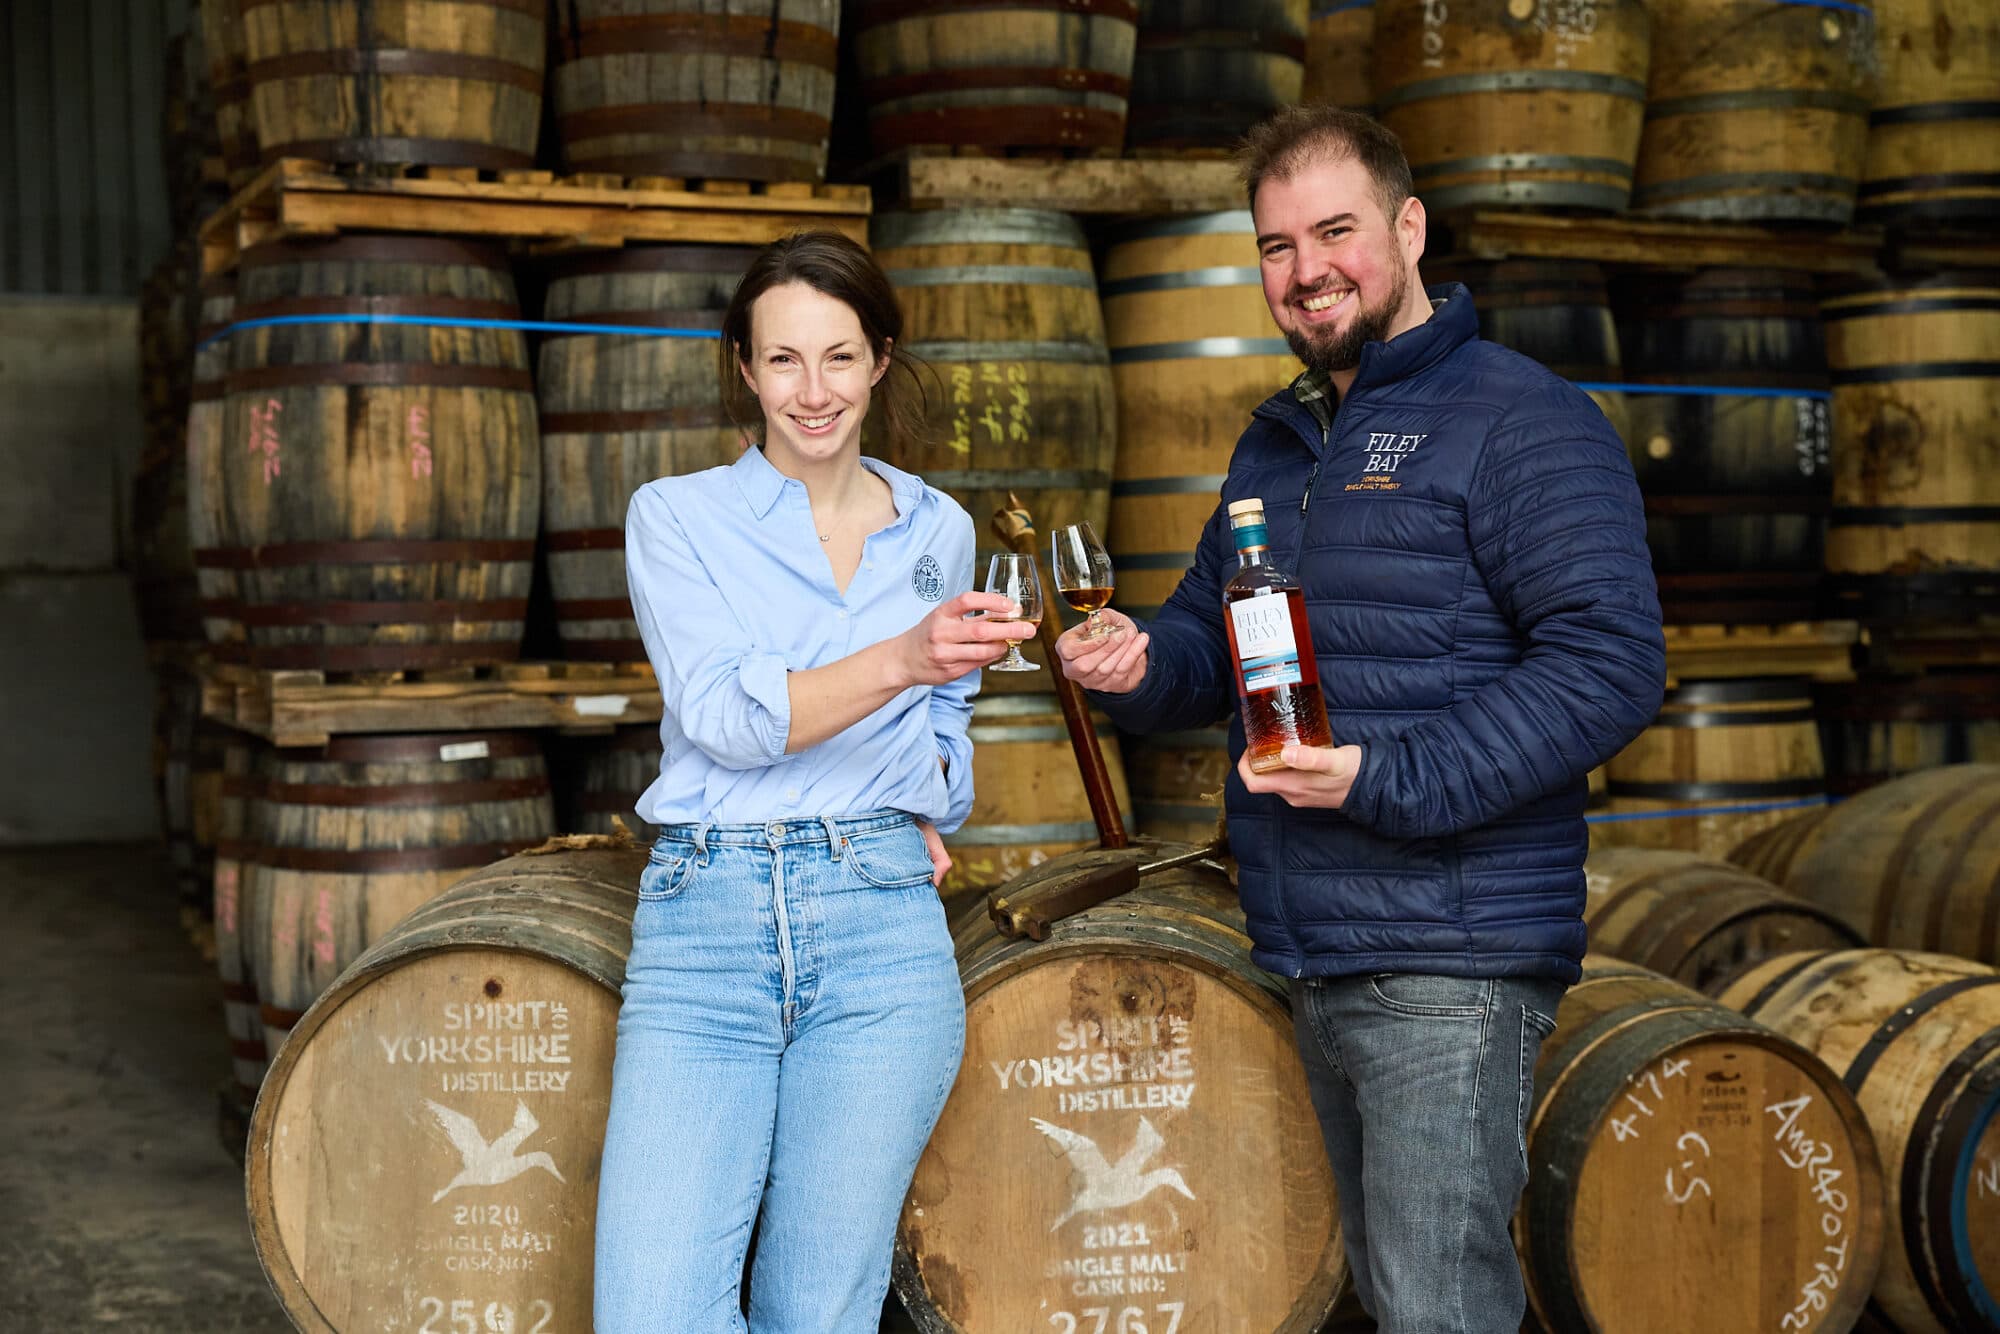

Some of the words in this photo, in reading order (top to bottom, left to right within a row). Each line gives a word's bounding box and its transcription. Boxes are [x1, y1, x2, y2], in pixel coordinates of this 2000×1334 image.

[1363, 432, 1428, 452] FILEY
[1362, 454, 1408, 472] BAY
[1237, 606, 1286, 629] FILEY
[1247, 623, 1279, 642] BAY
[444, 1000, 547, 1031] SPIRIT
[551, 1001, 569, 1030] OF
[1056, 1015, 1159, 1051] SPIRIT
[379, 1034, 571, 1064] YORKSHIRE
[991, 1047, 1195, 1090] YORKSHIRE
[442, 1071, 571, 1093] DISTILLERY
[1059, 1082, 1195, 1114] DISTILLERY
[453, 1205, 520, 1226] 2020
[1083, 1222, 1151, 1249] 2021
[1130, 1251, 1187, 1273] MALT
[1071, 1276, 1124, 1297] CASK
